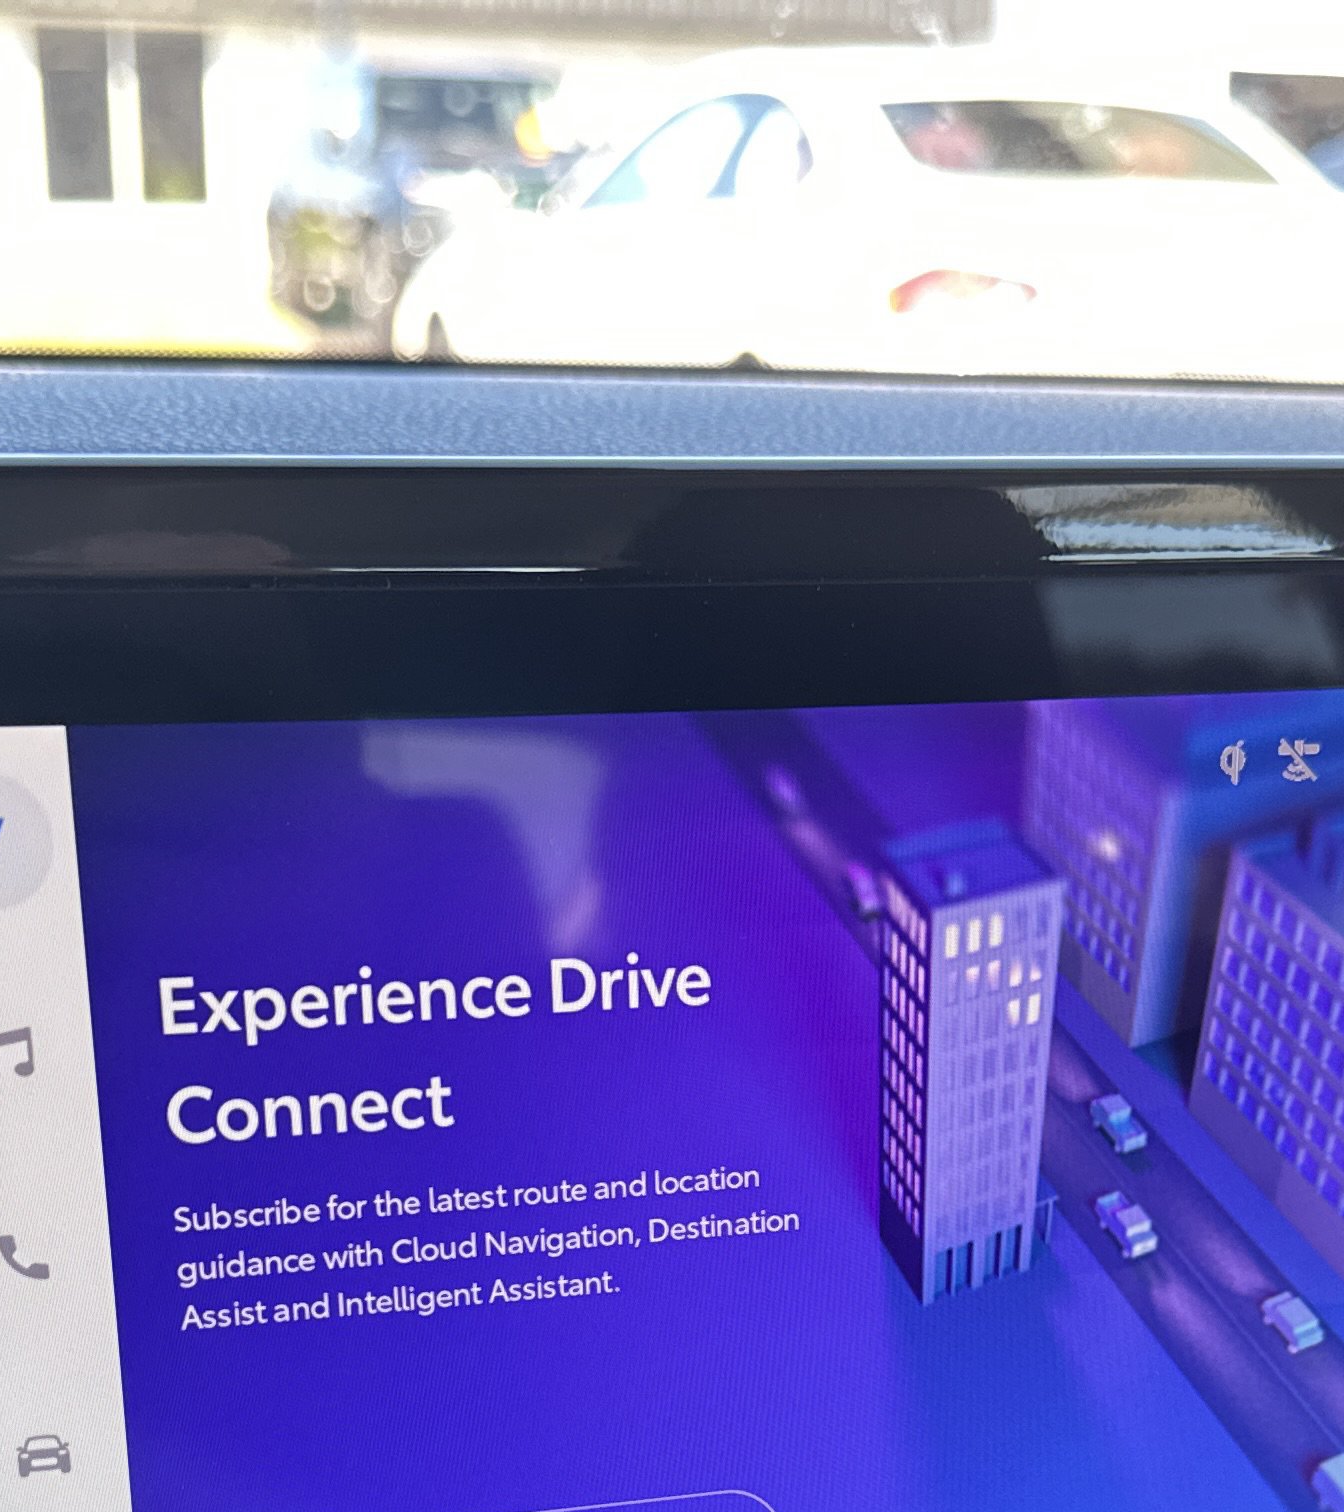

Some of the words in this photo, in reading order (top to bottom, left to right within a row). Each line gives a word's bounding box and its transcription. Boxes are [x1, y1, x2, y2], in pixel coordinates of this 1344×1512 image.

[158, 965, 532, 1046] Experience
[550, 952, 712, 1013] Drive
[166, 1076, 455, 1144] Connect
[173, 1196, 321, 1232] Subscribe
[327, 1193, 368, 1223] for
[373, 1189, 421, 1217] the
[428, 1183, 508, 1213] latest
[513, 1178, 588, 1207] route
[593, 1171, 648, 1201] and
[654, 1166, 761, 1194] location
[177, 1247, 316, 1288] guidance
[323, 1240, 384, 1270] with
[391, 1233, 478, 1264] Cloud
[485, 1220, 643, 1259] Navigation,
[648, 1208, 801, 1243] Destination
[181, 1301, 268, 1331] Assist
[273, 1292, 331, 1322] and
[338, 1280, 483, 1318] Intelligent
[489, 1271, 621, 1302] Assistant.
